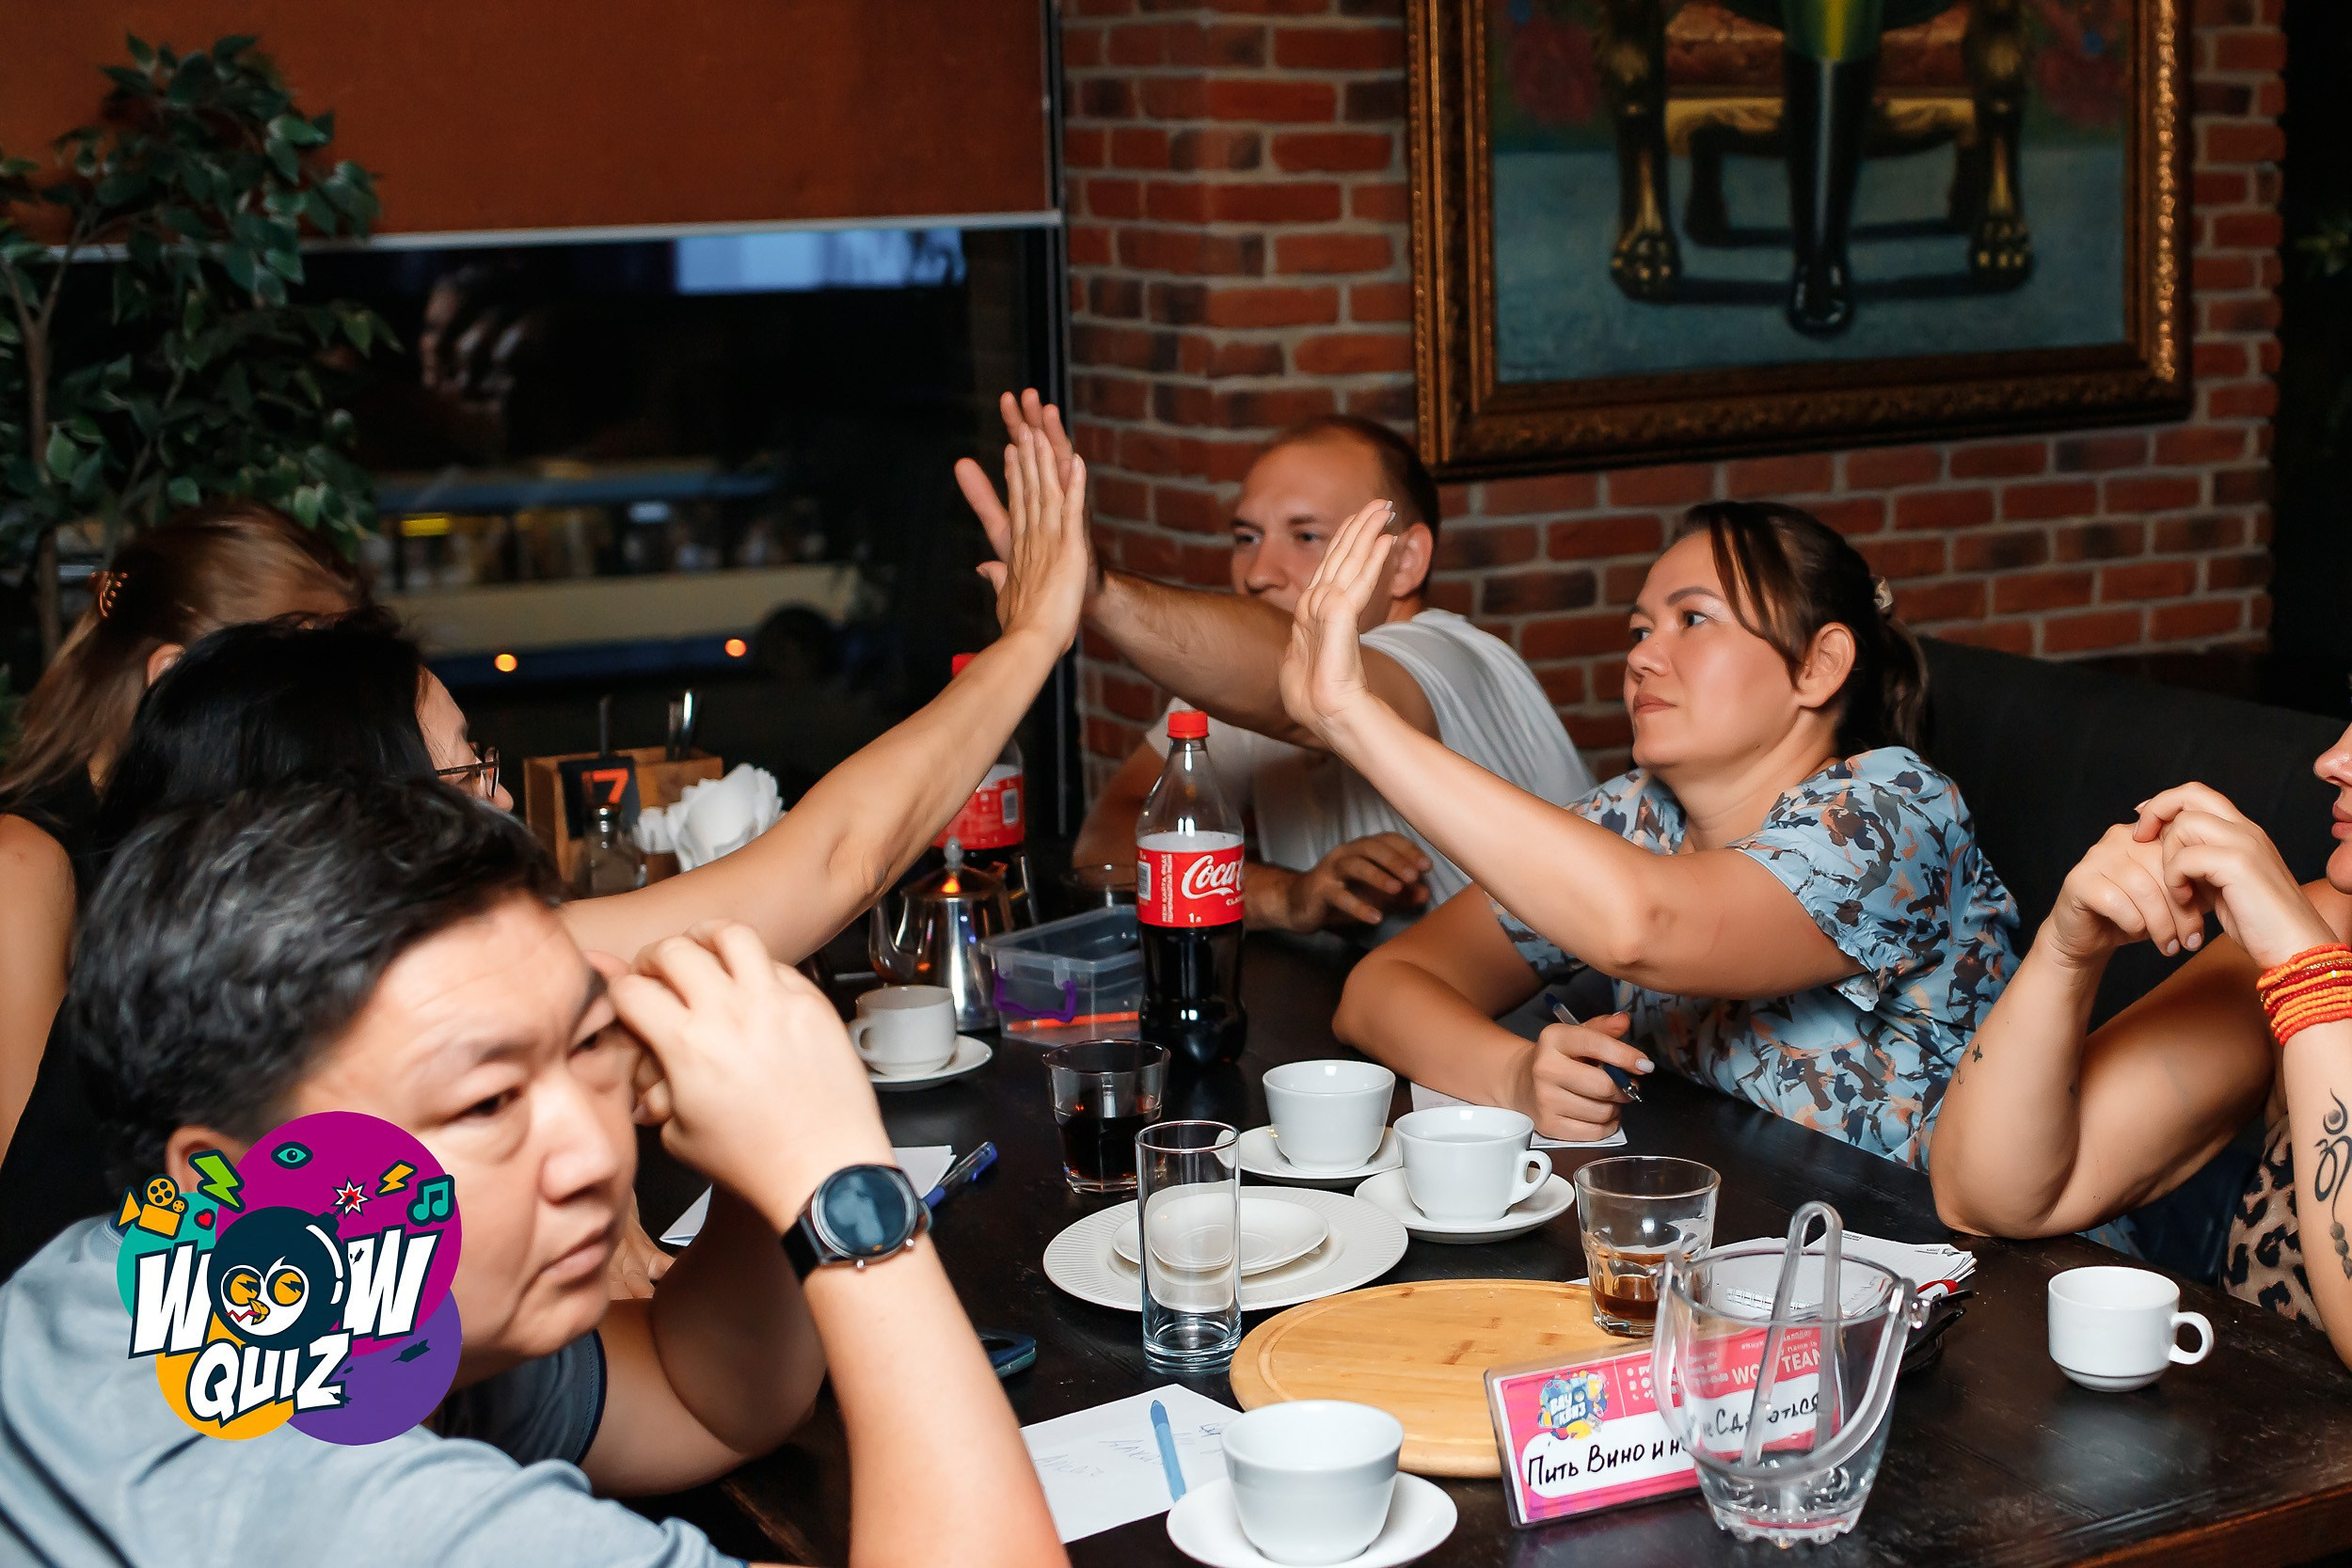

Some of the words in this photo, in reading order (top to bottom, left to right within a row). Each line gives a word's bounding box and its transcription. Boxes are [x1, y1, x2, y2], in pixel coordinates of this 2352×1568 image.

[1732, 1362, 1760, 1386] WO
[1528, 1454, 1579, 1488] Пить
[1587, 1444, 1645, 1473] Вино
[1652, 1439, 1664, 1461] и
